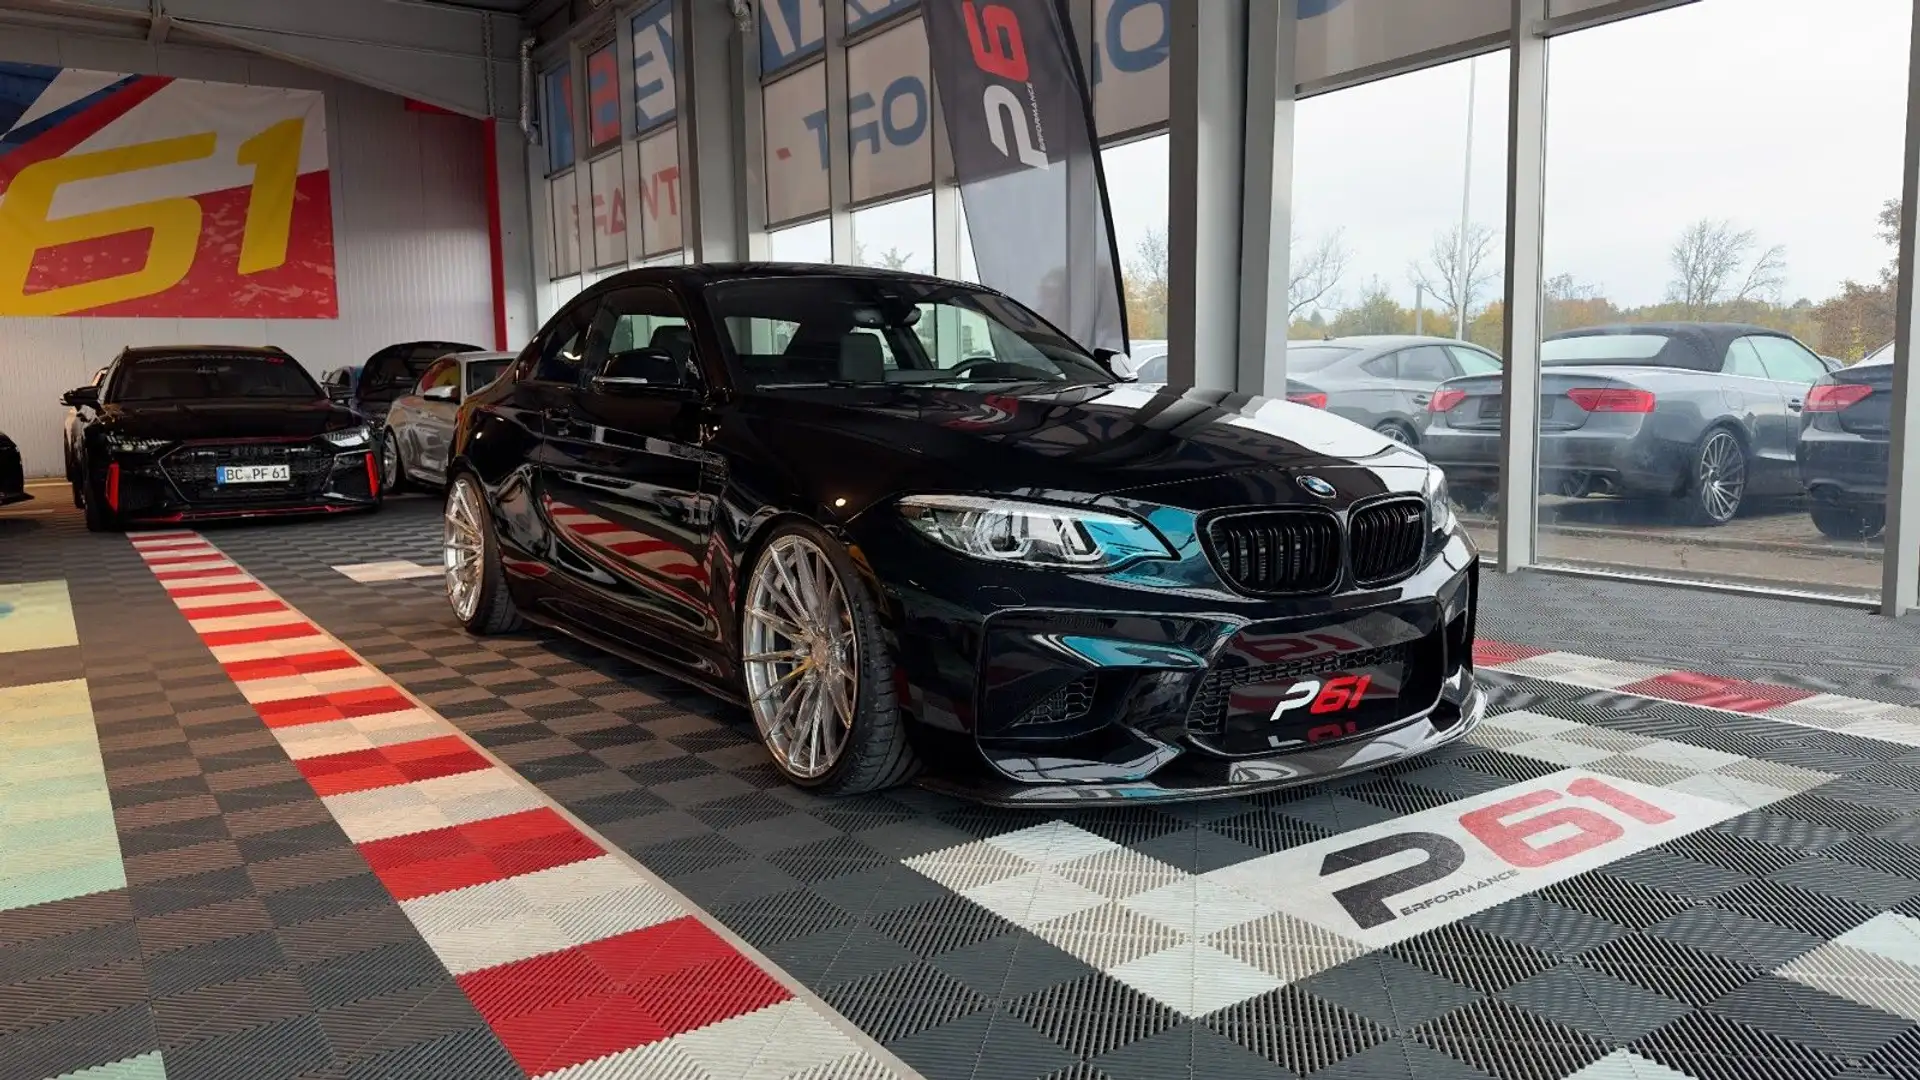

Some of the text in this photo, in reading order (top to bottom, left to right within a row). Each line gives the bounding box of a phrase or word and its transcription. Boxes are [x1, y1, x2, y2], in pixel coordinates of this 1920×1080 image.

[0, 117, 305, 316] 61
[226, 467, 288, 481] BC PF 61
[1269, 674, 1372, 722] P61
[1319, 777, 1676, 930] P61
